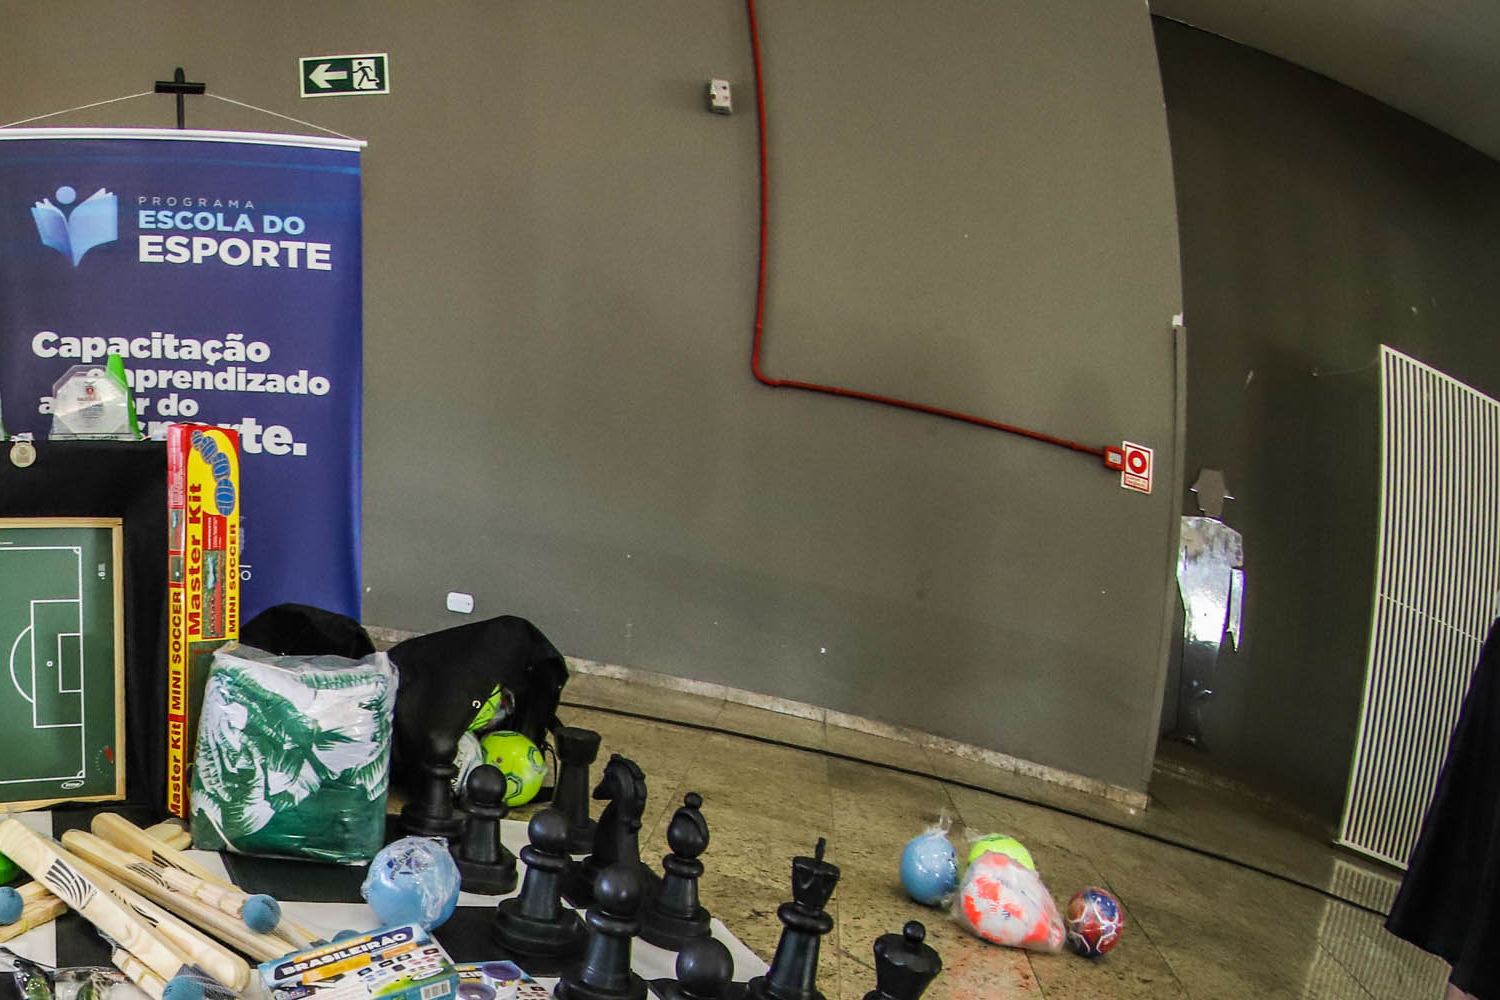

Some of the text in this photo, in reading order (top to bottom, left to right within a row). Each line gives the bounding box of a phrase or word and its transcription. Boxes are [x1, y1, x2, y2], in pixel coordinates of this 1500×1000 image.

[138, 196, 255, 209] PROGRAMA
[138, 209, 306, 235] ESCOLA DO
[138, 235, 332, 271] ESPORTE
[32, 331, 271, 366] Capacitação
[127, 367, 331, 396] prendizado
[157, 393, 199, 417] do
[188, 482, 202, 636] Master Kit
[229, 523, 237, 633] MINI SOCCER
[172, 591, 182, 711] MINI SOCCER
[170, 723, 182, 817] Master Kit
[281, 932, 408, 976] BRASILEIRÃO
